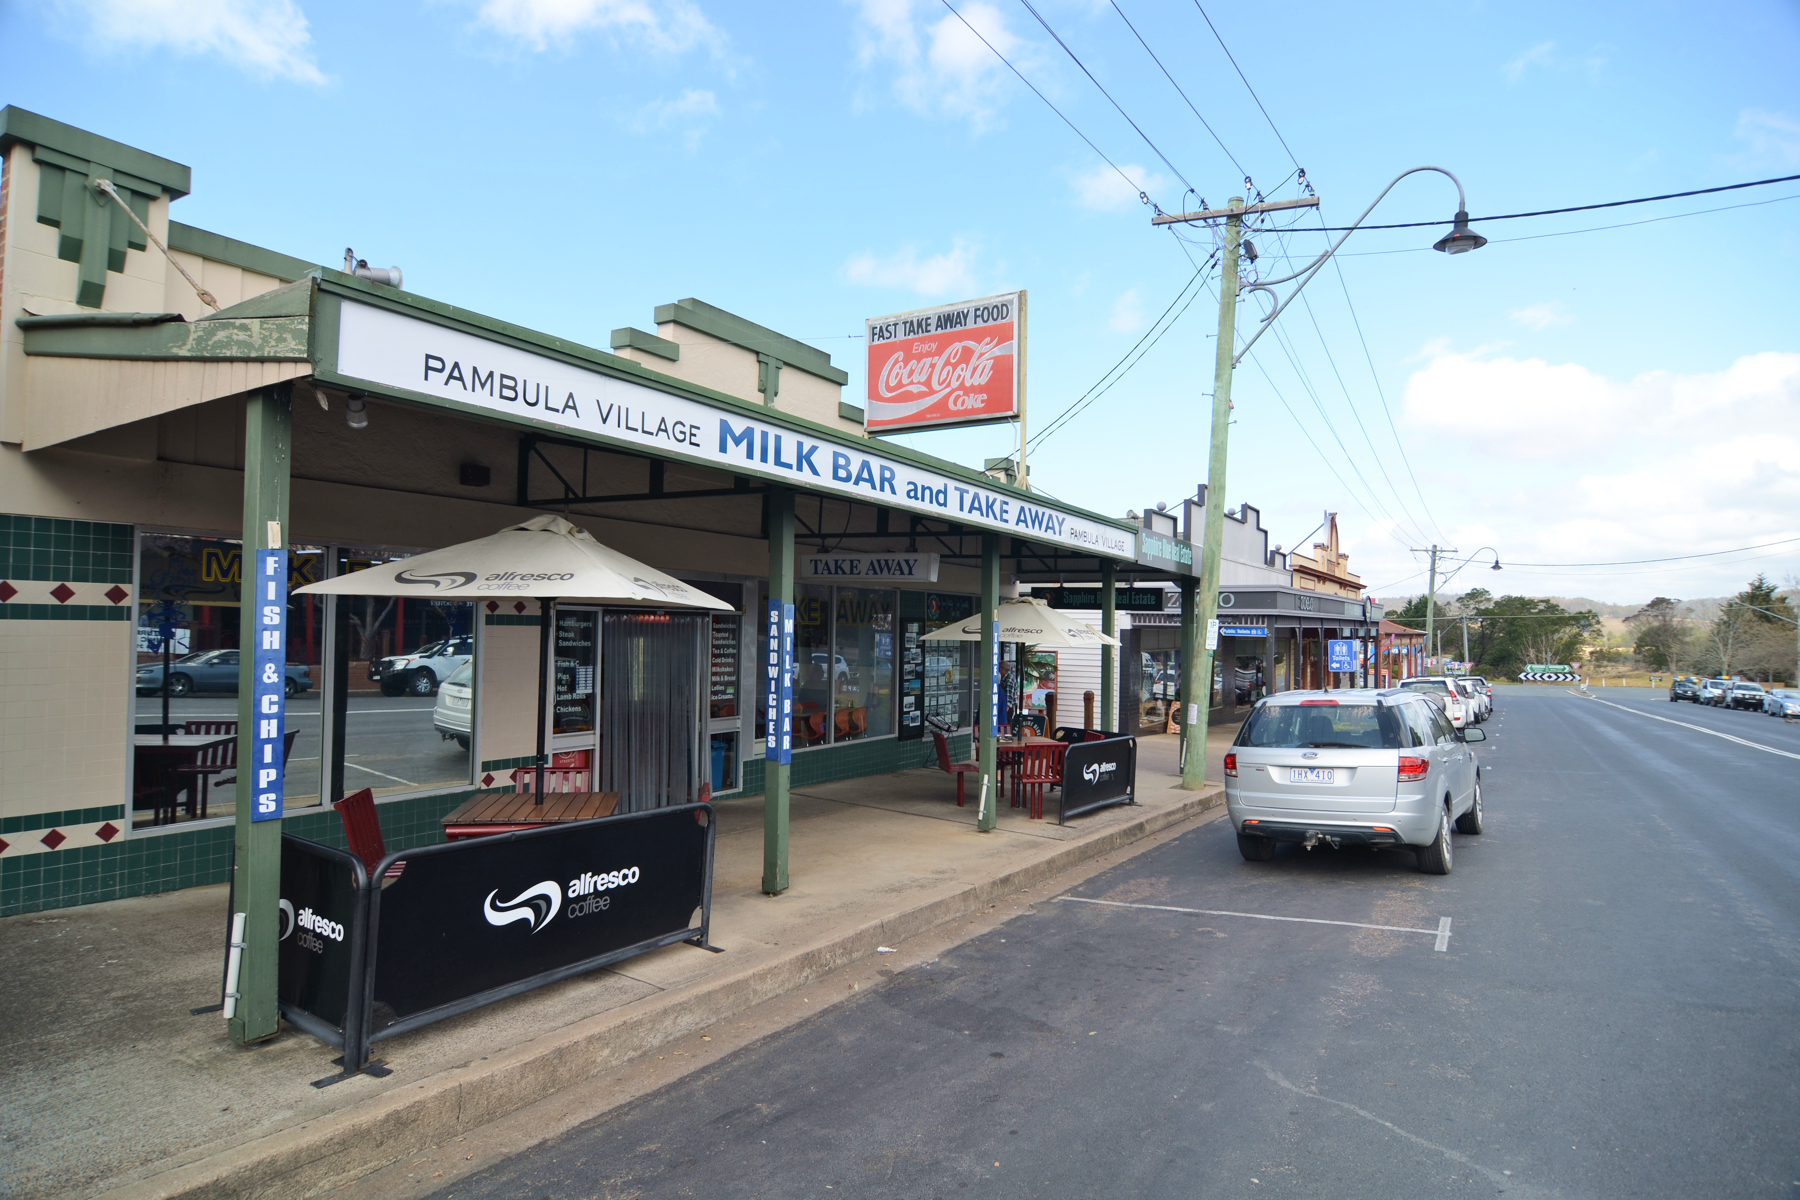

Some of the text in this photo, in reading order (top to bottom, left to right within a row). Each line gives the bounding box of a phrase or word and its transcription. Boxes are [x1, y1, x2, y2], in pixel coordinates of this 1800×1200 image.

[871, 303, 1010, 343] FAST TAKE AWAY FOOD
[912, 341, 939, 354] Enjoy
[878, 336, 999, 398] Coca-Cola
[948, 391, 988, 411] Coke
[424, 353, 1126, 553] PAMBULA VILLAGE MILK BAR and TAKE AWAY PAMBULA VILLAGE
[1142, 532, 1162, 560] Sapphire
[1172, 541, 1180, 562] Real
[1180, 543, 1192, 565] Estate
[203, 548, 317, 585] MK
[484, 571, 575, 581] alfresco
[810, 558, 918, 576] TAKE AWAY
[477, 582, 530, 591] coffee
[1063, 591, 1095, 606] Sapphire
[1131, 591, 1156, 605] Estate
[558, 620, 592, 628] Hamburgers
[258, 556, 280, 814] FISH & CHIPS
[767, 610, 779, 748] SANDWICHES
[783, 619, 793, 750] MILK BAR
[1293, 769, 1309, 780] 1HX
[568, 865, 640, 898] alfresco
[568, 894, 611, 919] coffee
[297, 906, 344, 943] alfresco
[297, 931, 324, 955] coffee
